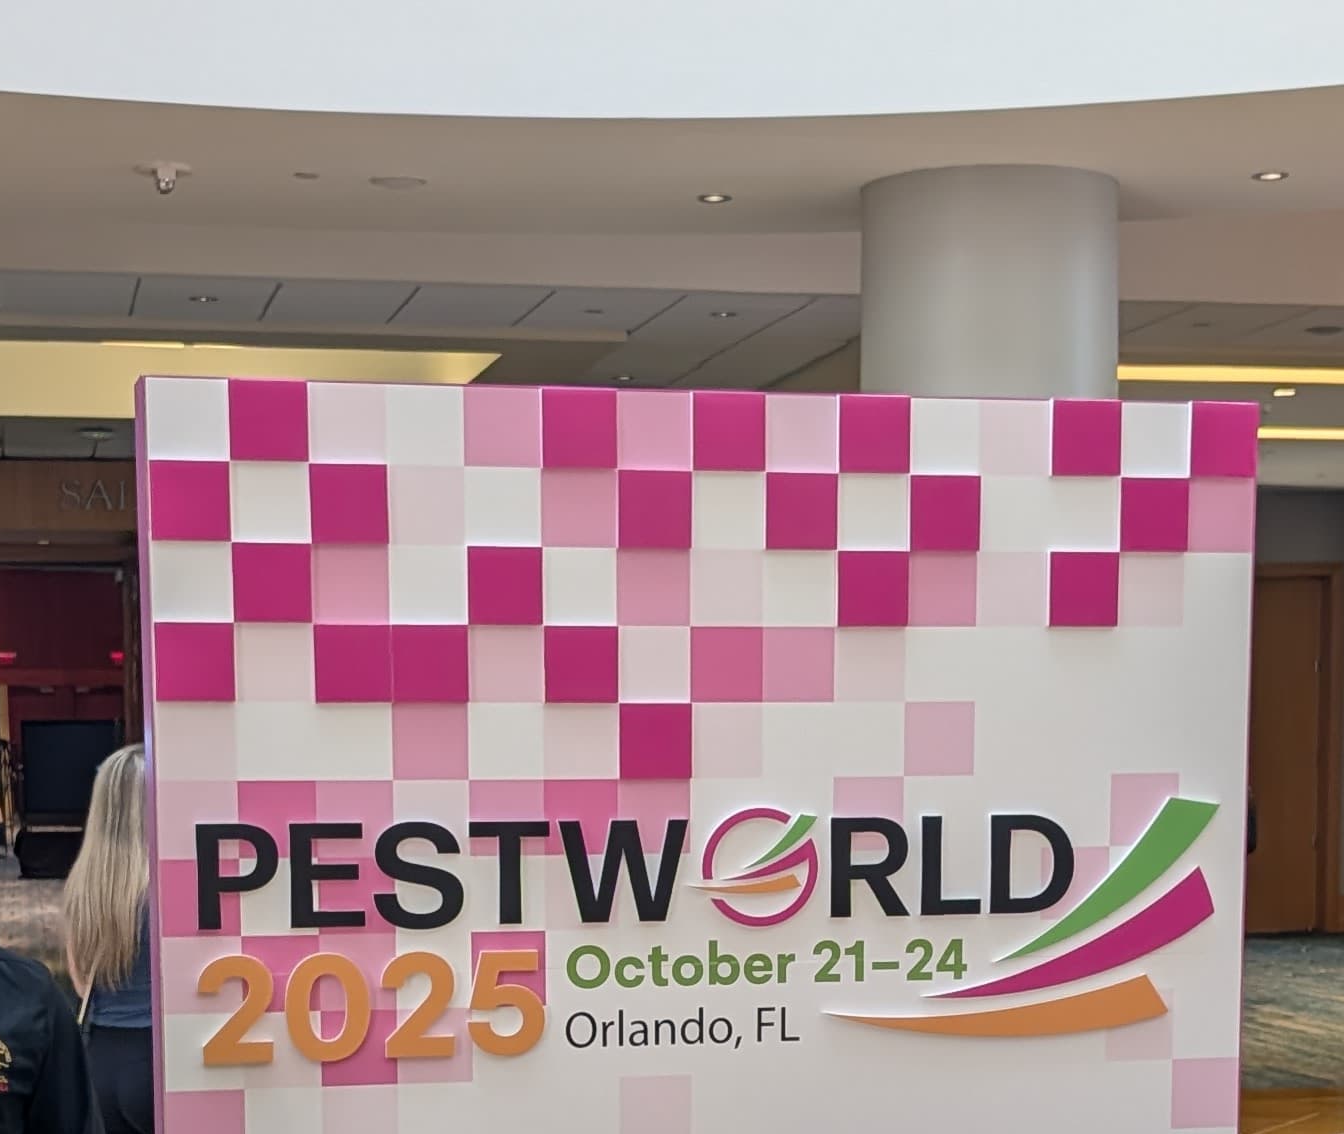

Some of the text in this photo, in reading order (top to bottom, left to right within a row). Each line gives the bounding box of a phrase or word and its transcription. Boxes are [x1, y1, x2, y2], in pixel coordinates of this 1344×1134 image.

[194, 807, 1076, 931] PESTWORLD
[196, 949, 545, 1066] 2025
[565, 941, 795, 991] October
[565, 1006, 801, 1052] Orlando, FL
